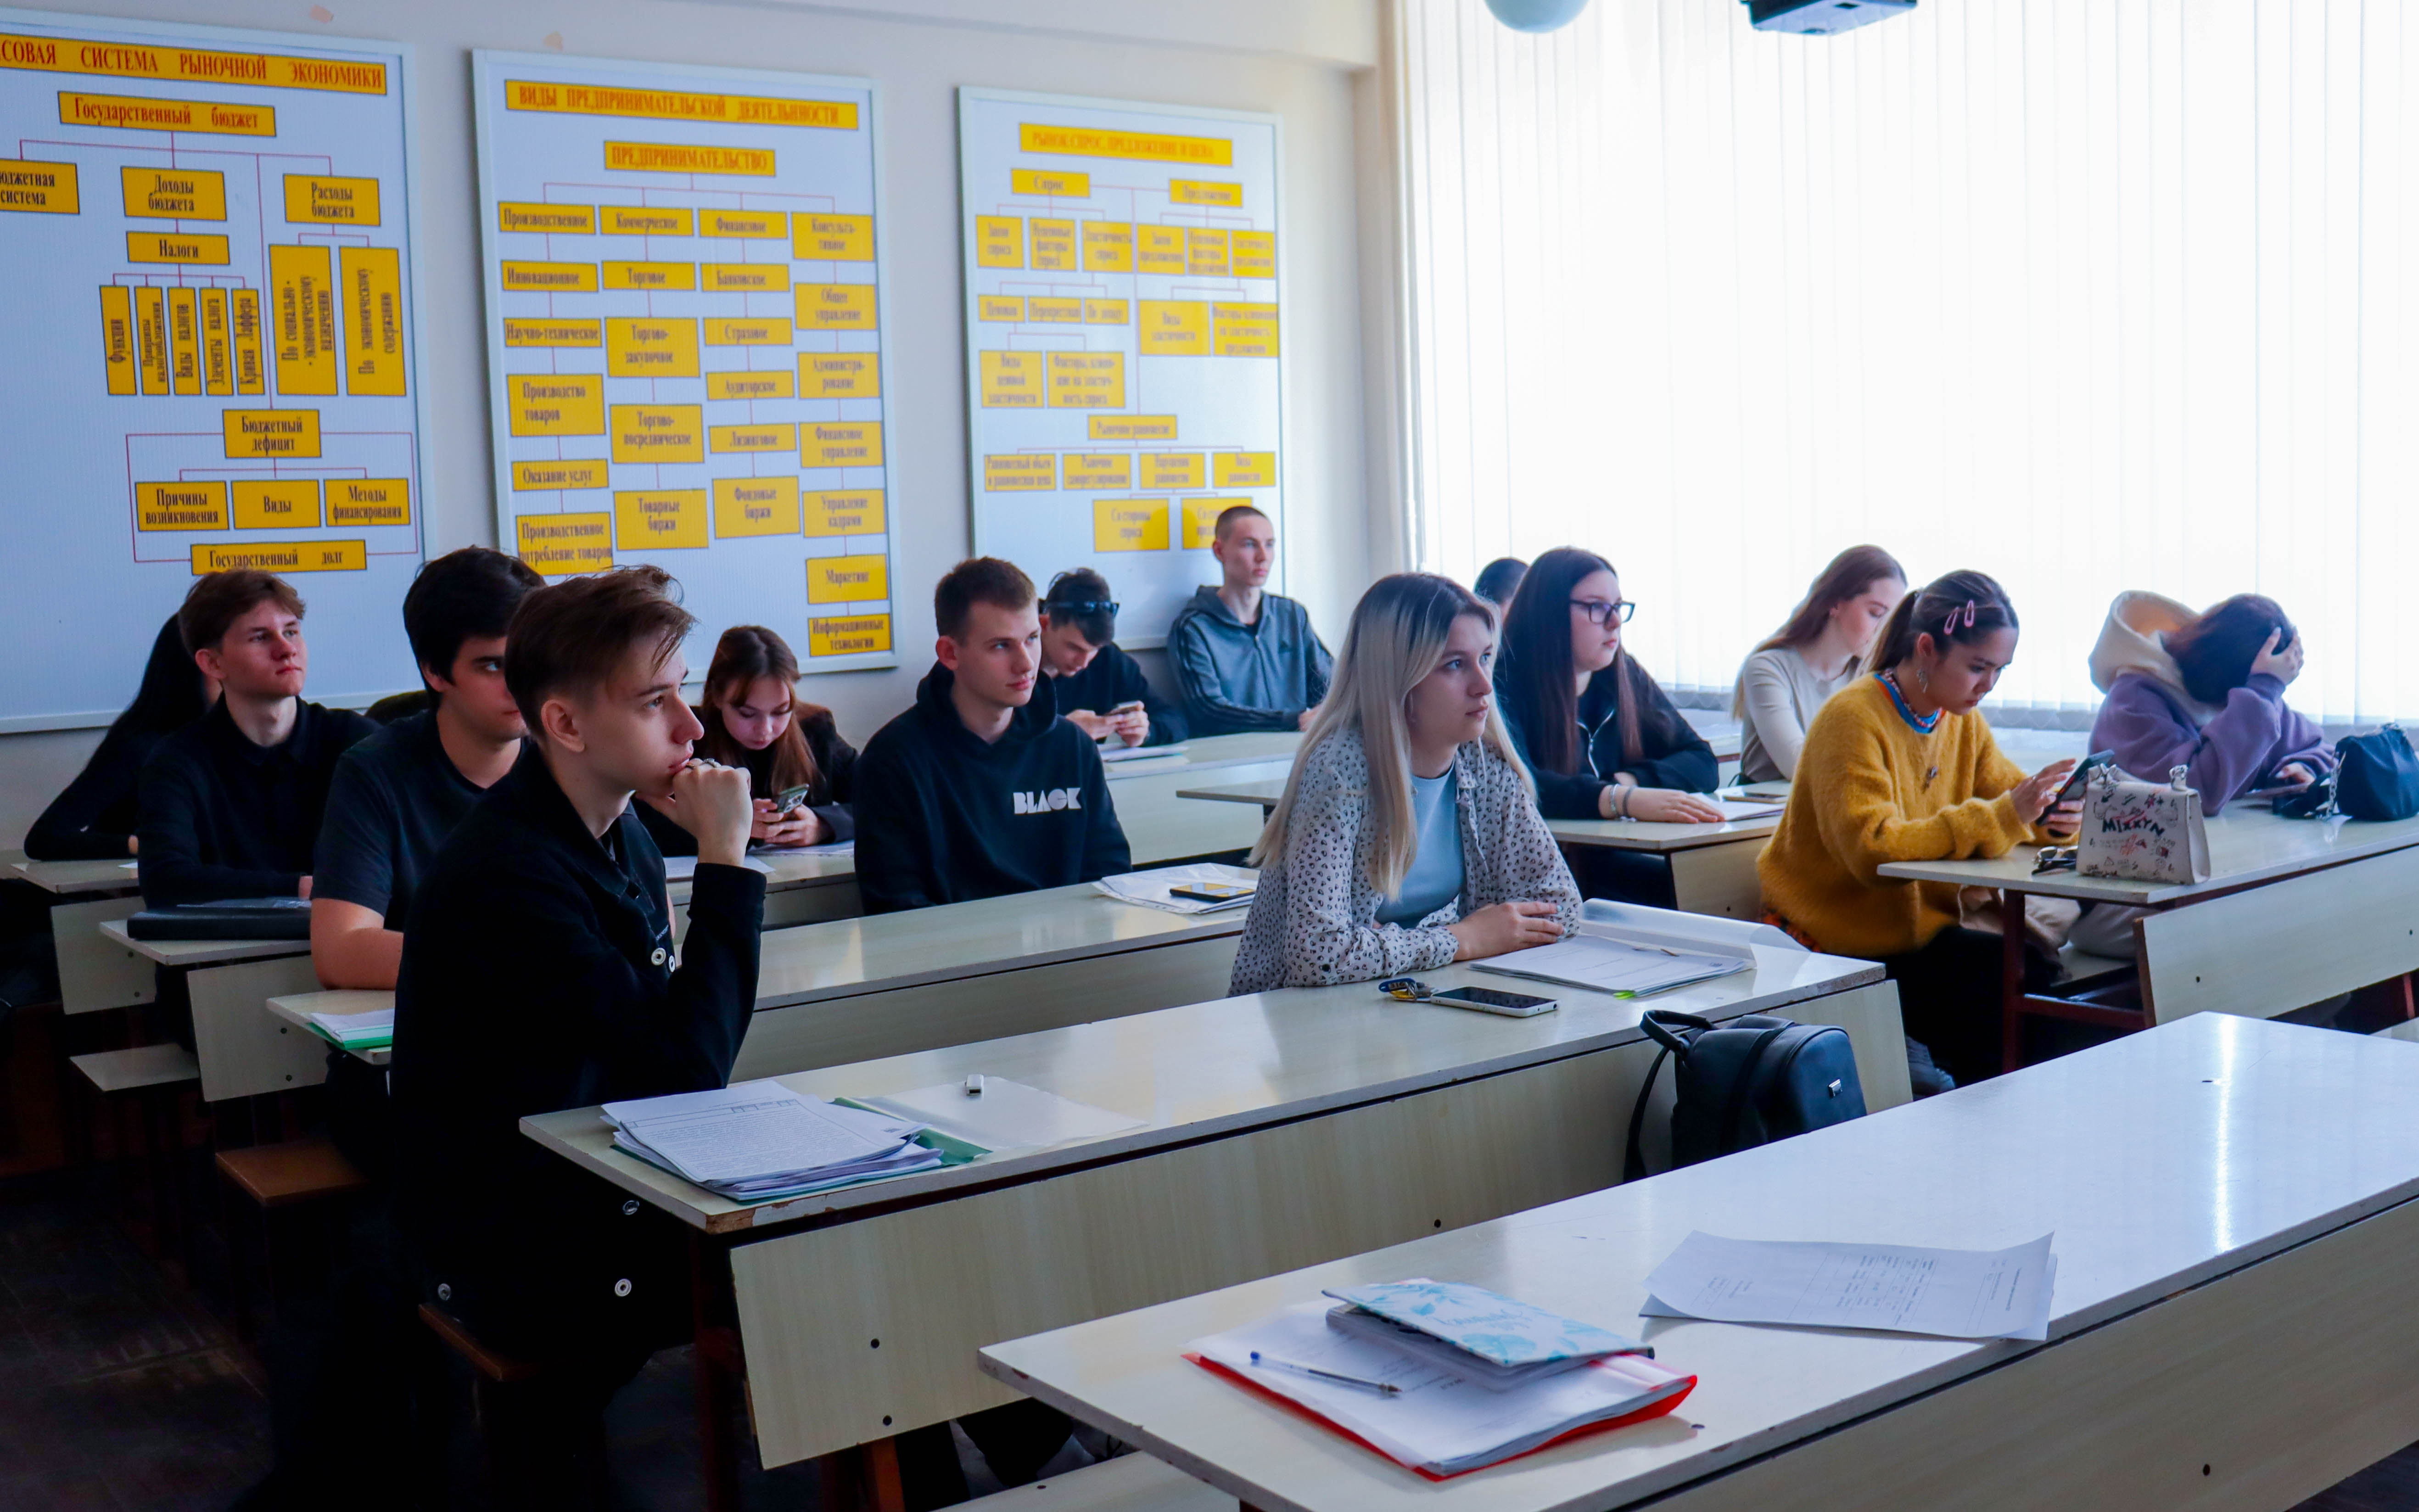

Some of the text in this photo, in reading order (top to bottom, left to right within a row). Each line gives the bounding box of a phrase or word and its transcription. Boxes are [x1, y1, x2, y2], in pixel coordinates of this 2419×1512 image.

[0, 39, 382, 88] СОВАЯ СИСТЕМА РЫНОЧНОЙ ЭКОНОМИКИ
[75, 97, 258, 128] Государственный бюджет
[519, 86, 838, 123] ВИДЫ ПРЕДПРИНИМАТЕЛЬСКОЙ ДЕЯТЕЛЬНОСТИ
[612, 146, 767, 171] ПРЕДПРИНИМАТЕЛЬСТВО
[154, 174, 194, 196] Доходы
[311, 182, 353, 201] Расходы
[1, 190, 45, 205] система
[148, 196, 195, 213] бюджета
[311, 201, 355, 218] бюджета
[504, 208, 587, 230] Производственное
[159, 239, 198, 259] Налоги
[176, 304, 193, 378] Виды налогов
[506, 324, 598, 345] Научно-техническое
[207, 339, 224, 385] Элементы
[281, 346, 298, 360] По
[358, 360, 375, 374] По
[523, 382, 585, 402] Производство
[242, 416, 302, 434] Бюджетный
[525, 409, 560, 425] товаров
[637, 411, 675, 430] Торгово-
[252, 435, 295, 455] дефицит
[523, 468, 592, 487] Оказание услуг
[157, 489, 207, 510] Причины
[348, 485, 387, 503] Методы
[263, 496, 291, 513] Виды
[333, 503, 401, 523] финансирования
[638, 497, 679, 513] Товарные
[146, 509, 218, 524] возникновения
[648, 515, 675, 535] биржи
[522, 522, 604, 543] Производственное
[210, 549, 342, 567] Государственный долг
[826, 569, 869, 586] Маркетинг
[813, 619, 884, 637] Информационные
[830, 638, 874, 651] технологии
[1013, 787, 1081, 814] BLACK
